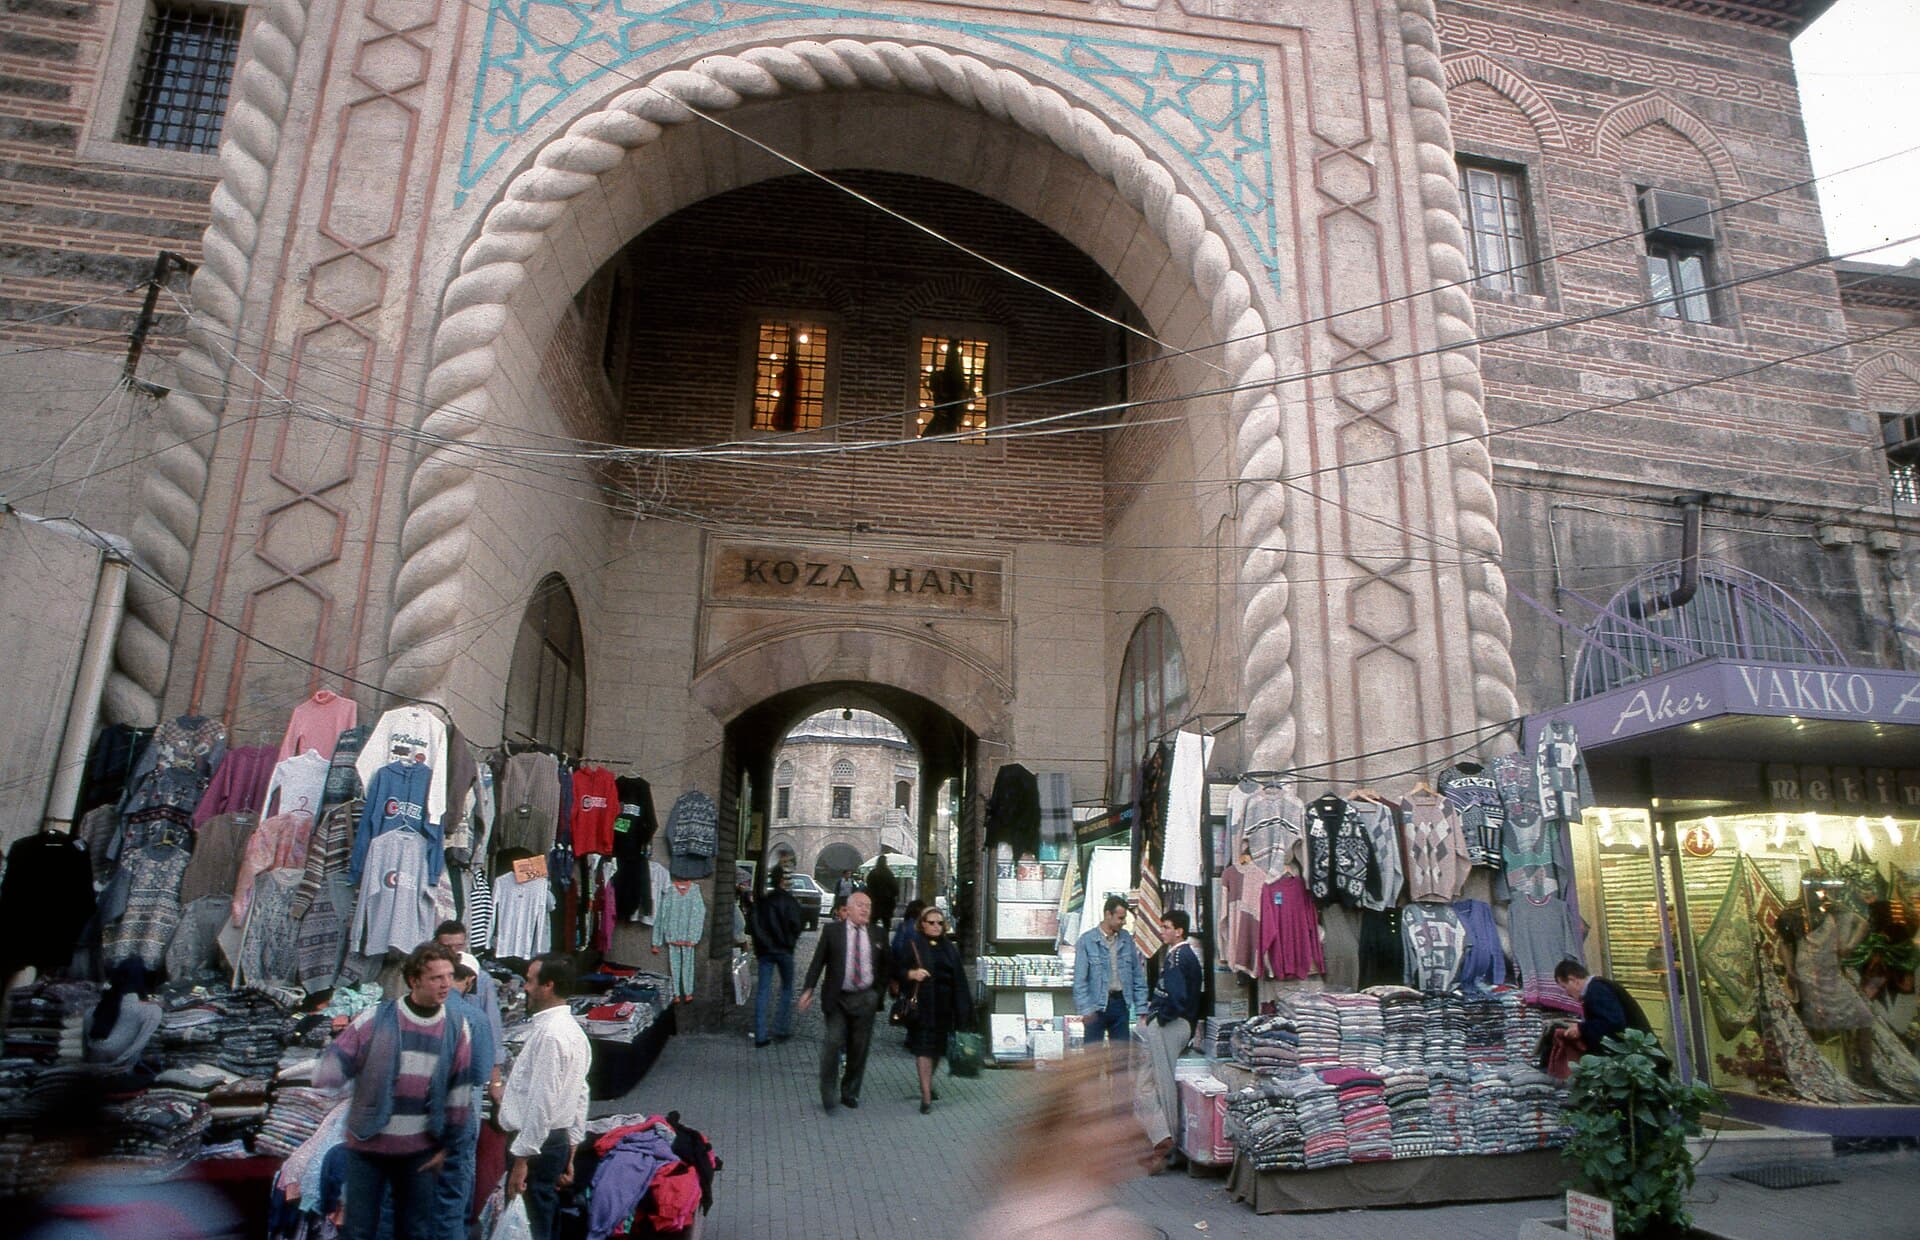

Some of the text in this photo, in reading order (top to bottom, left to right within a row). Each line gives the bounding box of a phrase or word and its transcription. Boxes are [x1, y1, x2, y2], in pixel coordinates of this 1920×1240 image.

[743, 559, 976, 595] KOZA HAN
[1611, 684, 1711, 735] Aker
[1735, 665, 1875, 714] VAKKO
